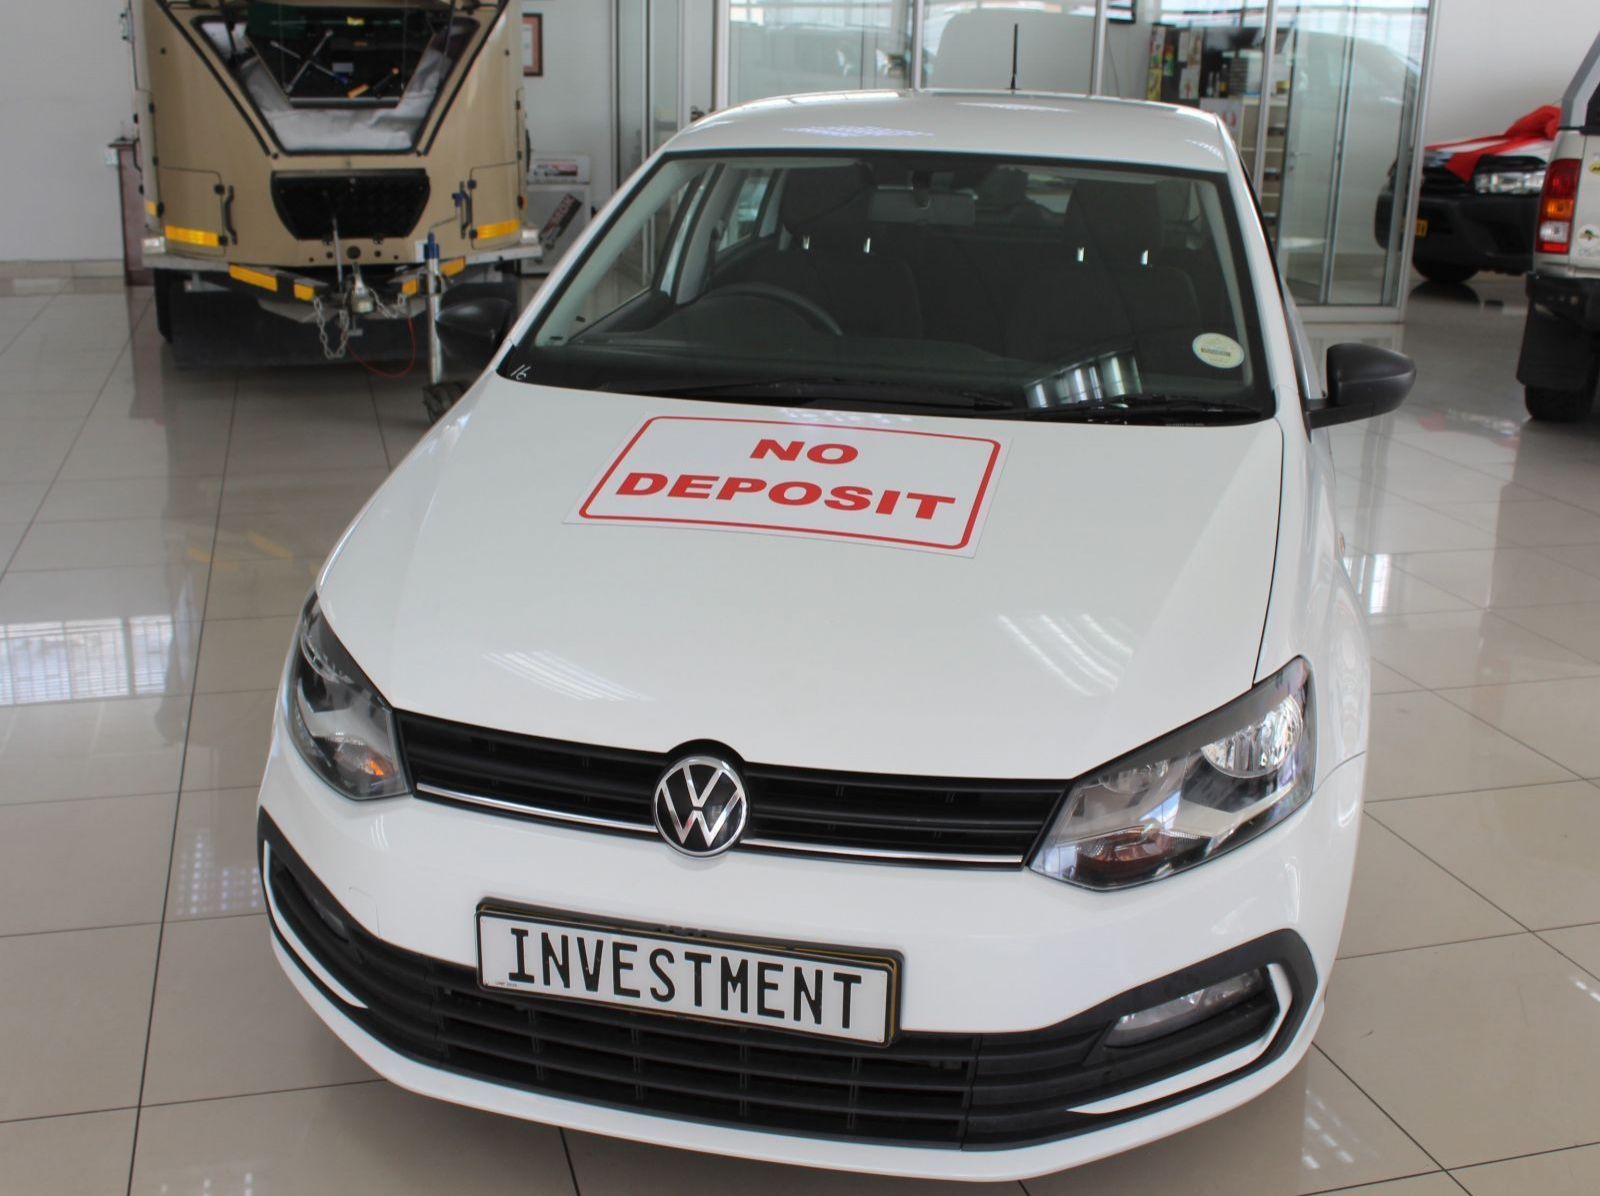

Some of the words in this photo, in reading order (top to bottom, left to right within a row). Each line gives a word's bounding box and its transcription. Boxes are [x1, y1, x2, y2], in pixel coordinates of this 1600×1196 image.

[751, 438, 858, 465] NO
[616, 472, 956, 520] DEPOSIT
[508, 927, 863, 1030] INVESTMENT
